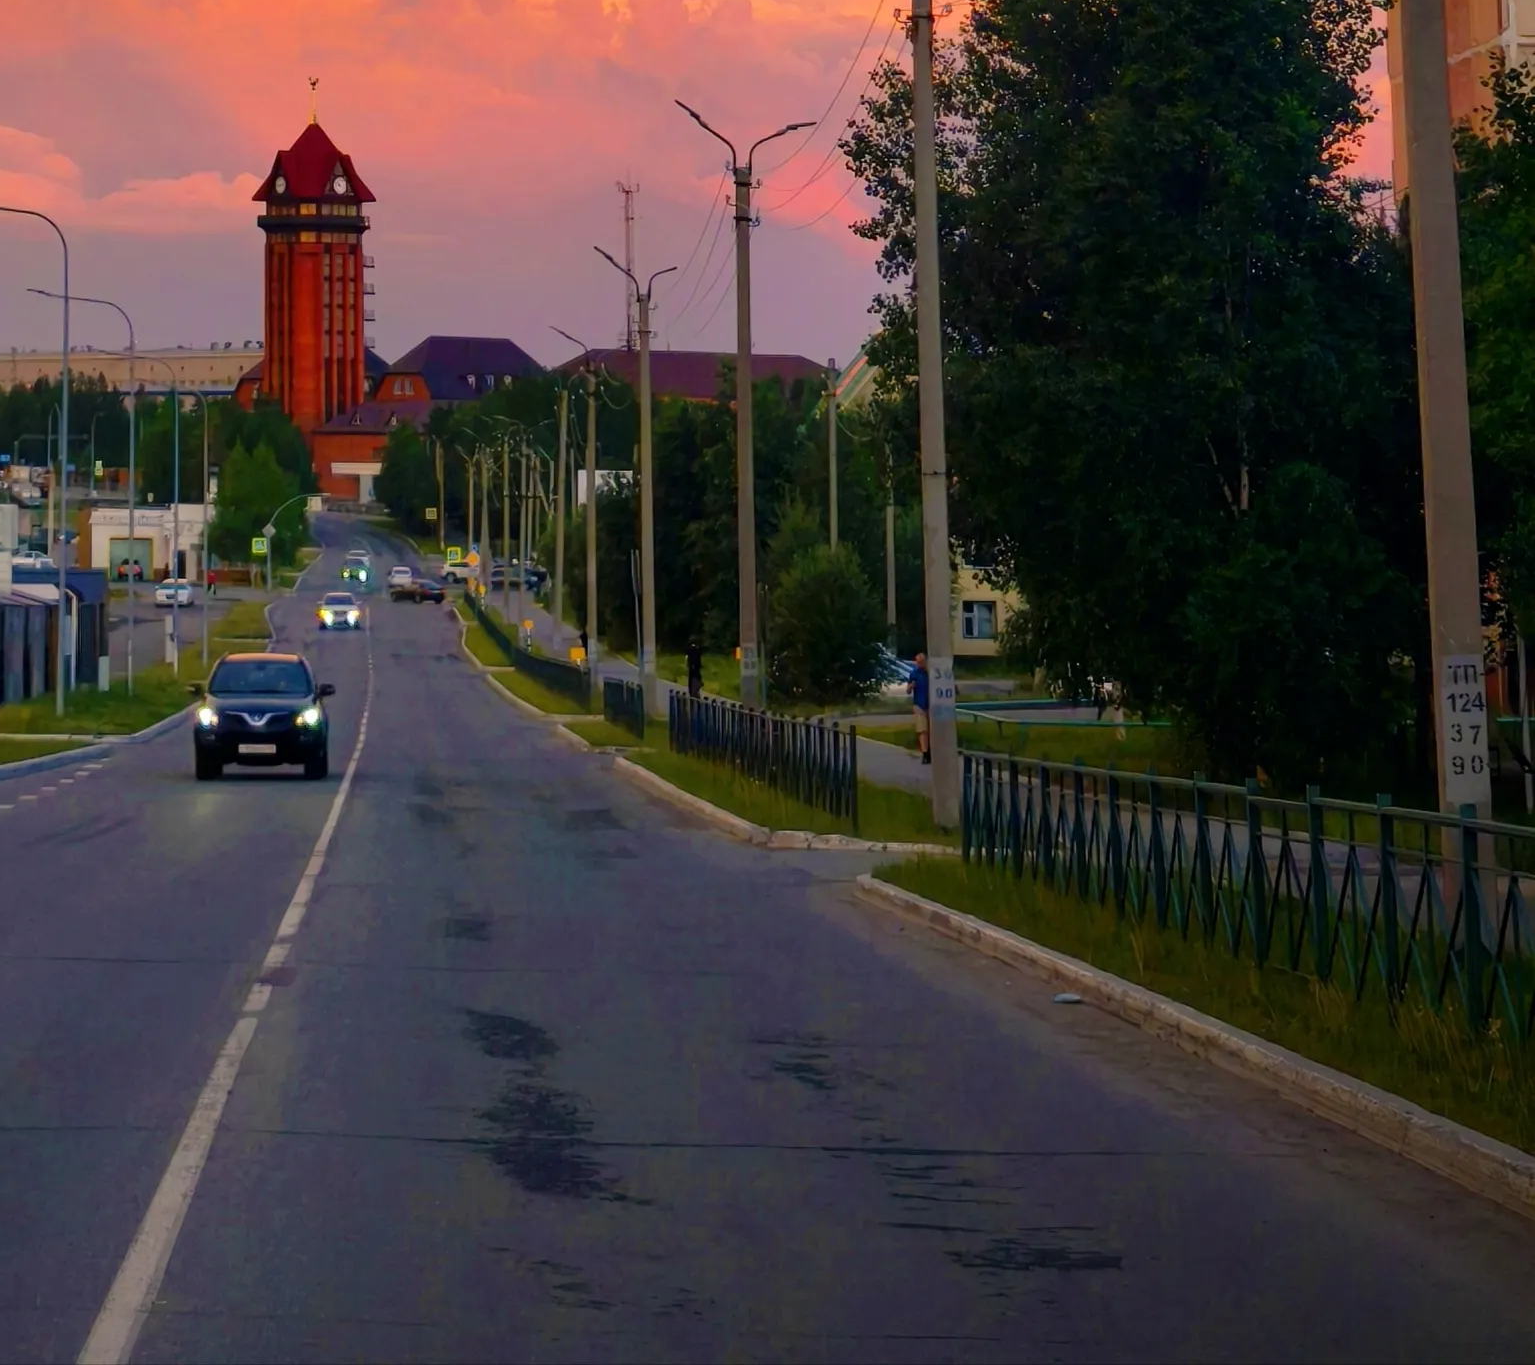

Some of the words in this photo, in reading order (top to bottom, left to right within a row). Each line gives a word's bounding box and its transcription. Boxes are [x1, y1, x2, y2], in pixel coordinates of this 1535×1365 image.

[1446, 691, 1486, 713] 124
[1450, 724, 1483, 745] 37
[1452, 755, 1485, 776] 90
